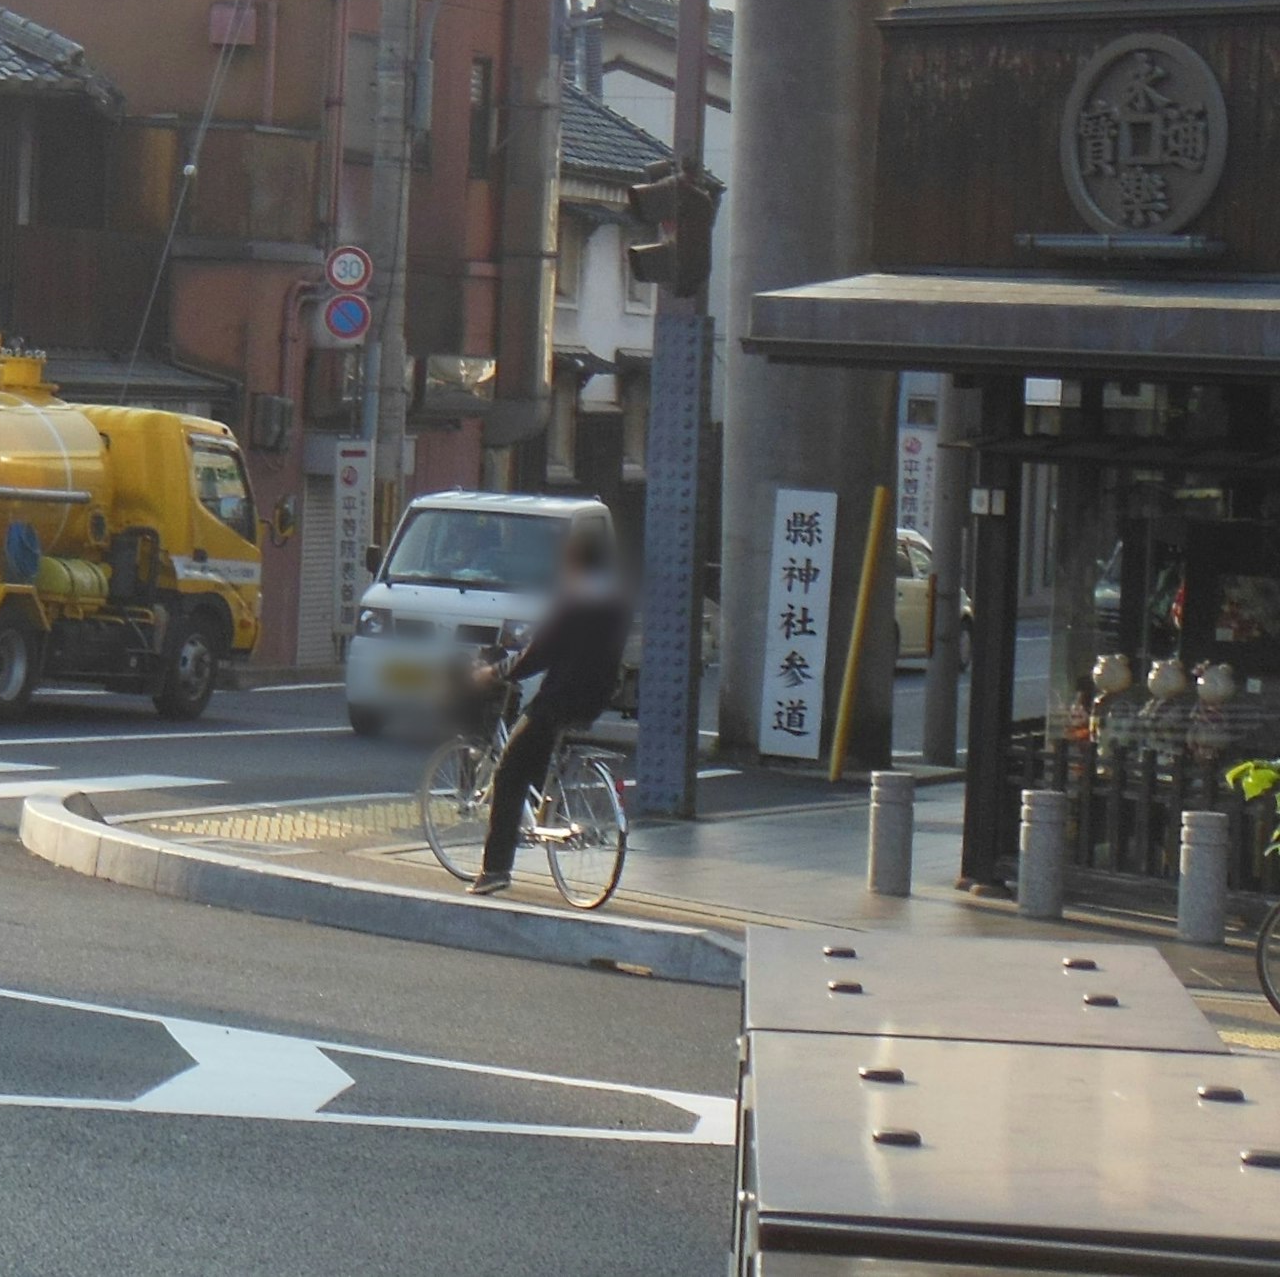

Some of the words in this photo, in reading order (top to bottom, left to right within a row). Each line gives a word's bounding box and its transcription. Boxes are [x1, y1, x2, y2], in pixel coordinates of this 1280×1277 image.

[337, 260, 362, 279] 30
[772, 510, 823, 738] 縣神社参道
